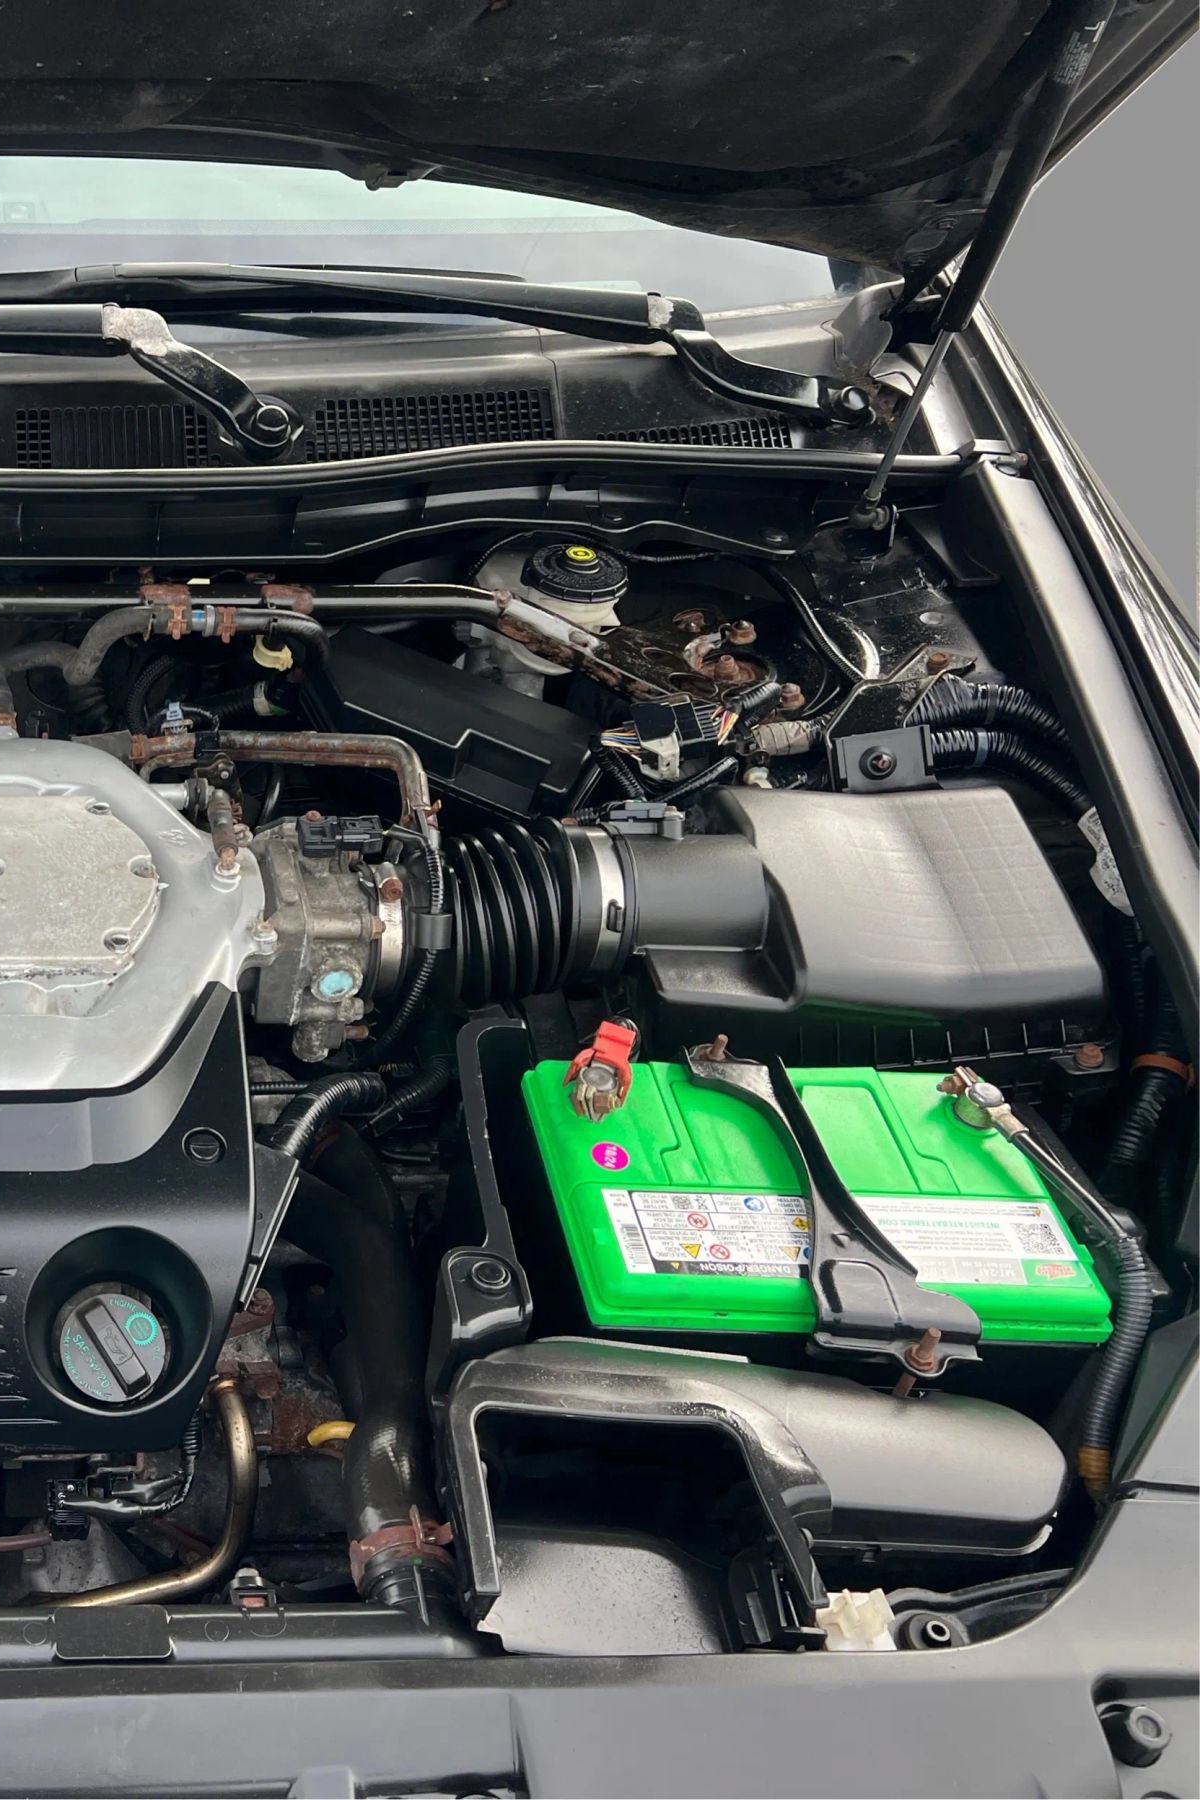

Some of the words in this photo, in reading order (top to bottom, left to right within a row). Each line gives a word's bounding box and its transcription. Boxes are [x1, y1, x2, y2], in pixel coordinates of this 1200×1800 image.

[699, 1263, 791, 1274] DANGER/POISON
[109, 1298, 137, 1312] ENGINE
[72, 1334, 90, 1353] SAE
